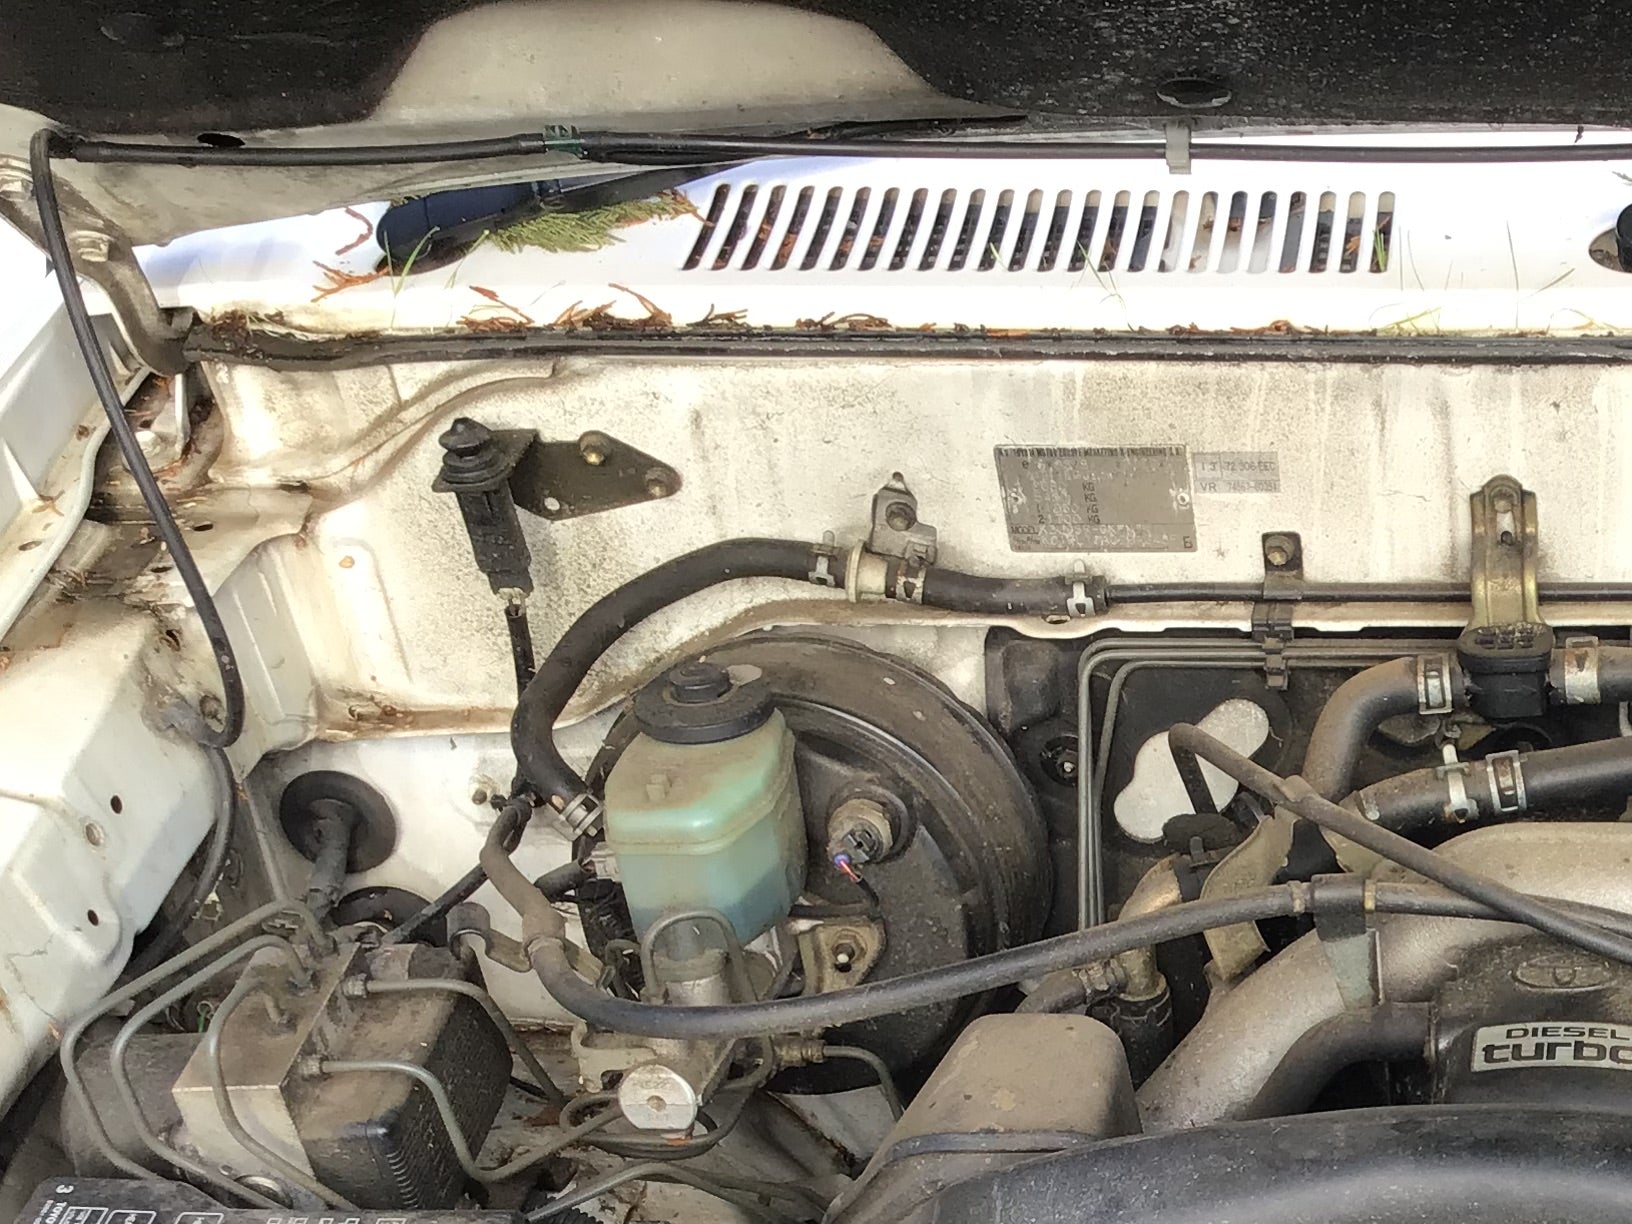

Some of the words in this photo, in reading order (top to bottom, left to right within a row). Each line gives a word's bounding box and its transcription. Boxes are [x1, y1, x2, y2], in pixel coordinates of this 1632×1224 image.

[1083, 482, 1095, 491] KG
[1200, 482, 1217, 492] VR
[1084, 493, 1097, 502] KG
[1088, 515, 1100, 524] KG
[1505, 1027, 1630, 1041] DIESEL
[56, 1185, 74, 1194] 3
